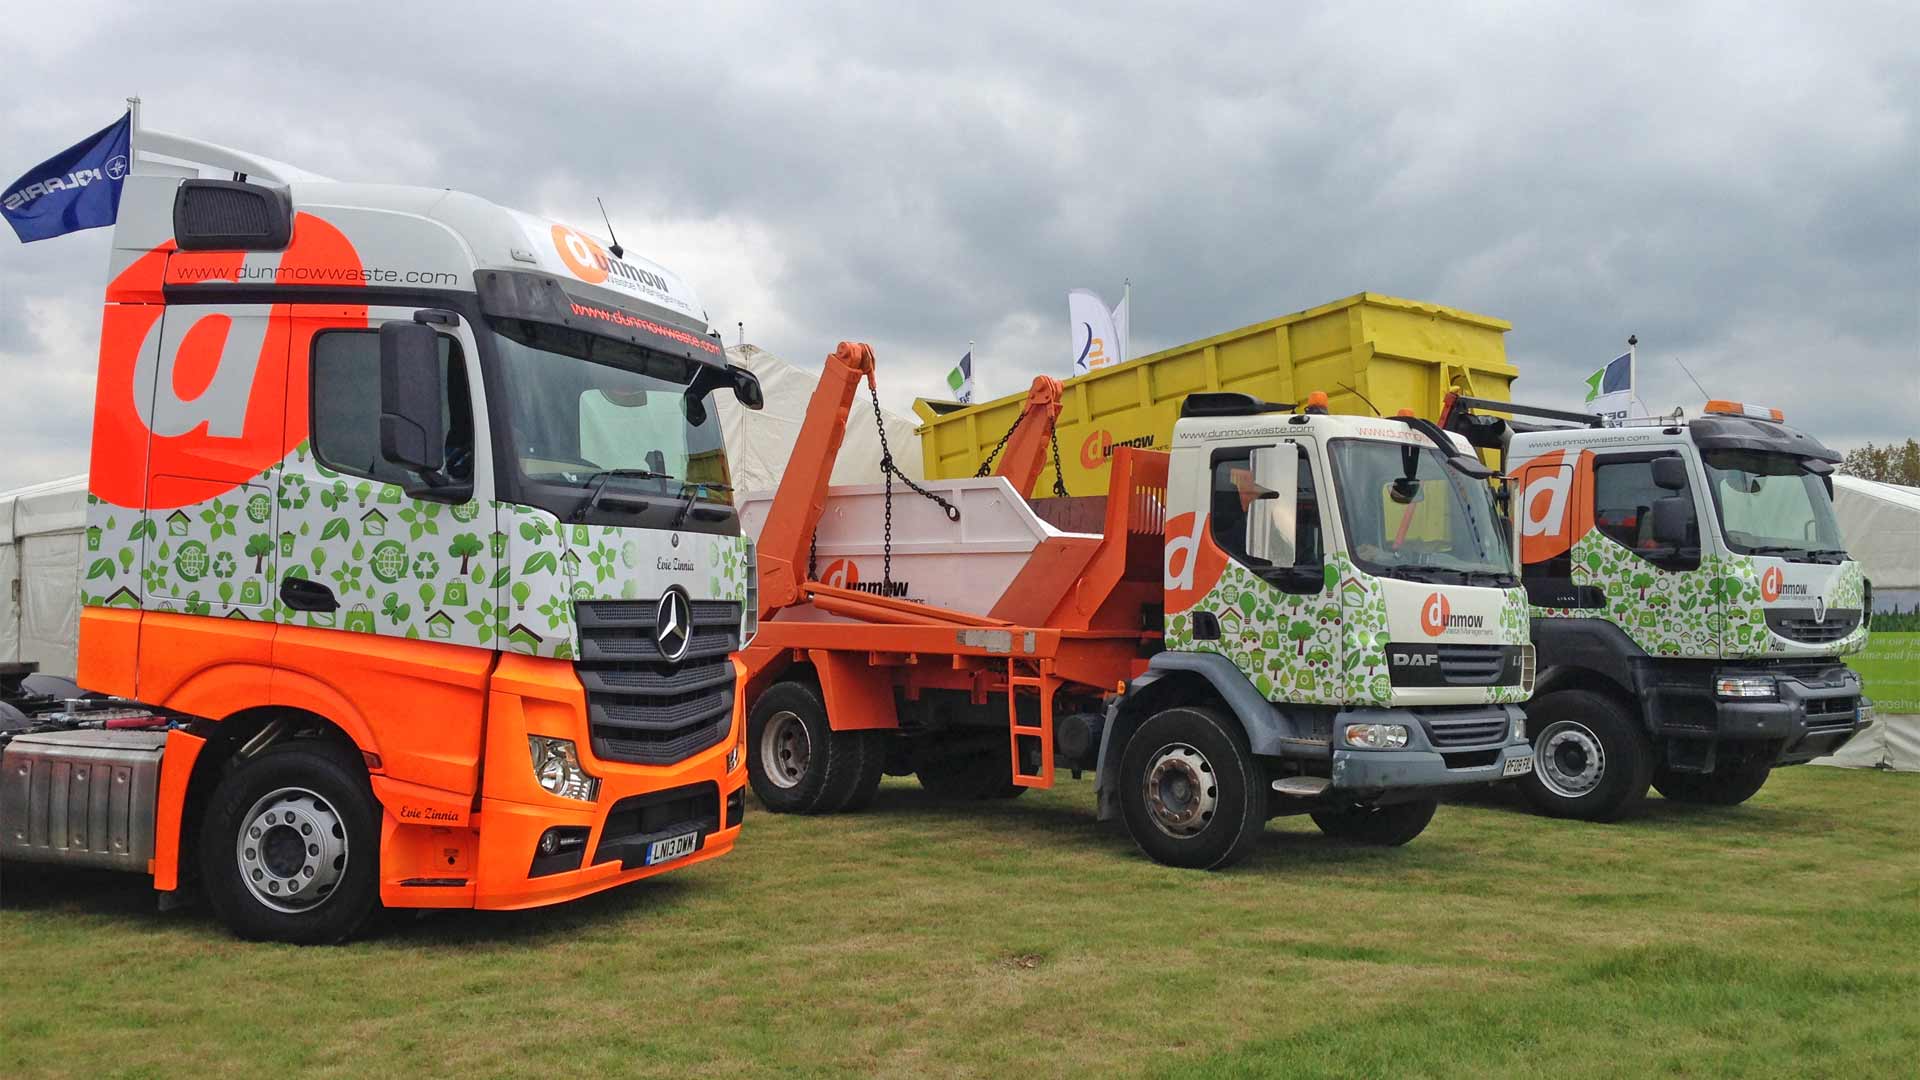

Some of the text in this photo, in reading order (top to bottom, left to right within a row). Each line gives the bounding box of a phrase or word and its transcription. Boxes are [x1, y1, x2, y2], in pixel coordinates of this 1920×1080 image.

[177, 263, 458, 285] wwwdunmowwaste.com
[570, 303, 721, 355] www.dunmowwaste.com
[1765, 567, 1807, 595] dunmow
[1426, 592, 1484, 629] dunmow
[1393, 654, 1438, 666] DAF
[401, 805, 459, 821] Evie Zinnia
[653, 840, 676, 861] LN13
